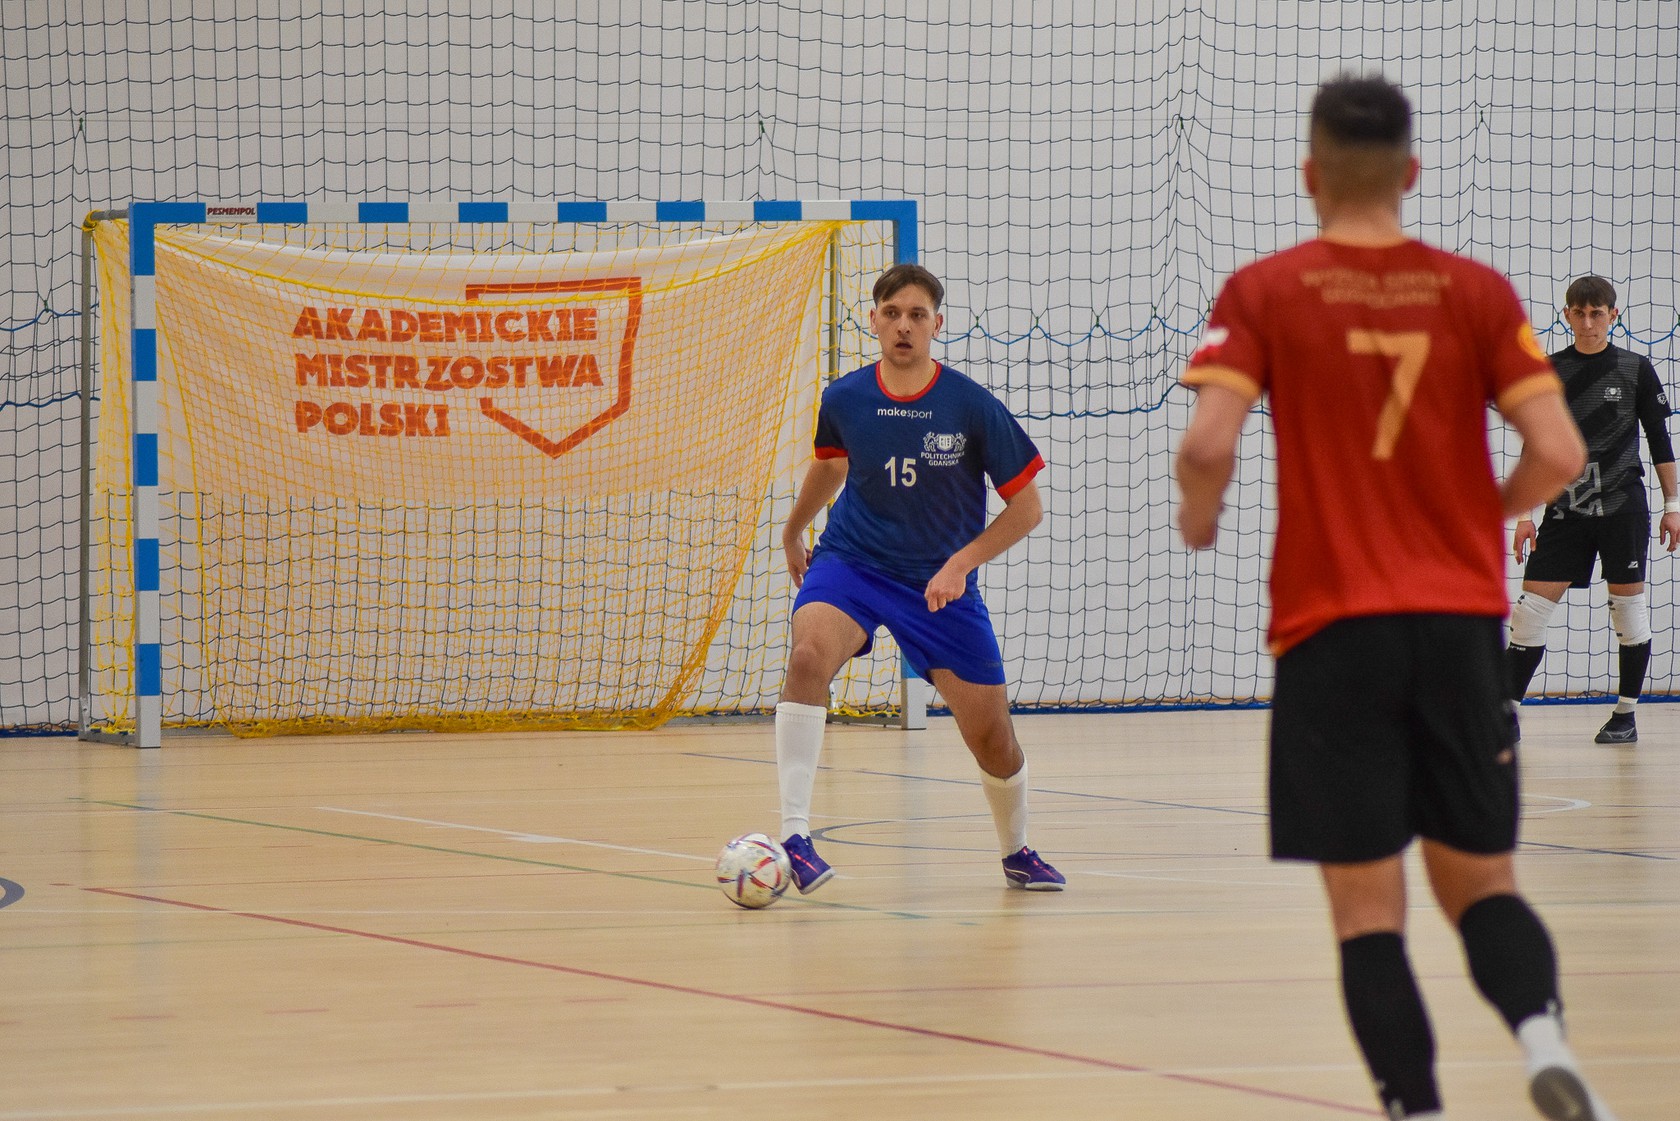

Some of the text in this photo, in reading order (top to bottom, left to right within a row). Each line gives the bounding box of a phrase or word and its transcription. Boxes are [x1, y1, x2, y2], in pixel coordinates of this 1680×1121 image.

[207, 207, 255, 215] PESMENPOL
[293, 307, 597, 342] AKADEMICKIE
[295, 354, 603, 391] MISTRZOSTWA
[1346, 330, 1430, 460] 7
[295, 401, 450, 437] POLSKI
[877, 407, 933, 419] makesport
[885, 456, 917, 487] 15
